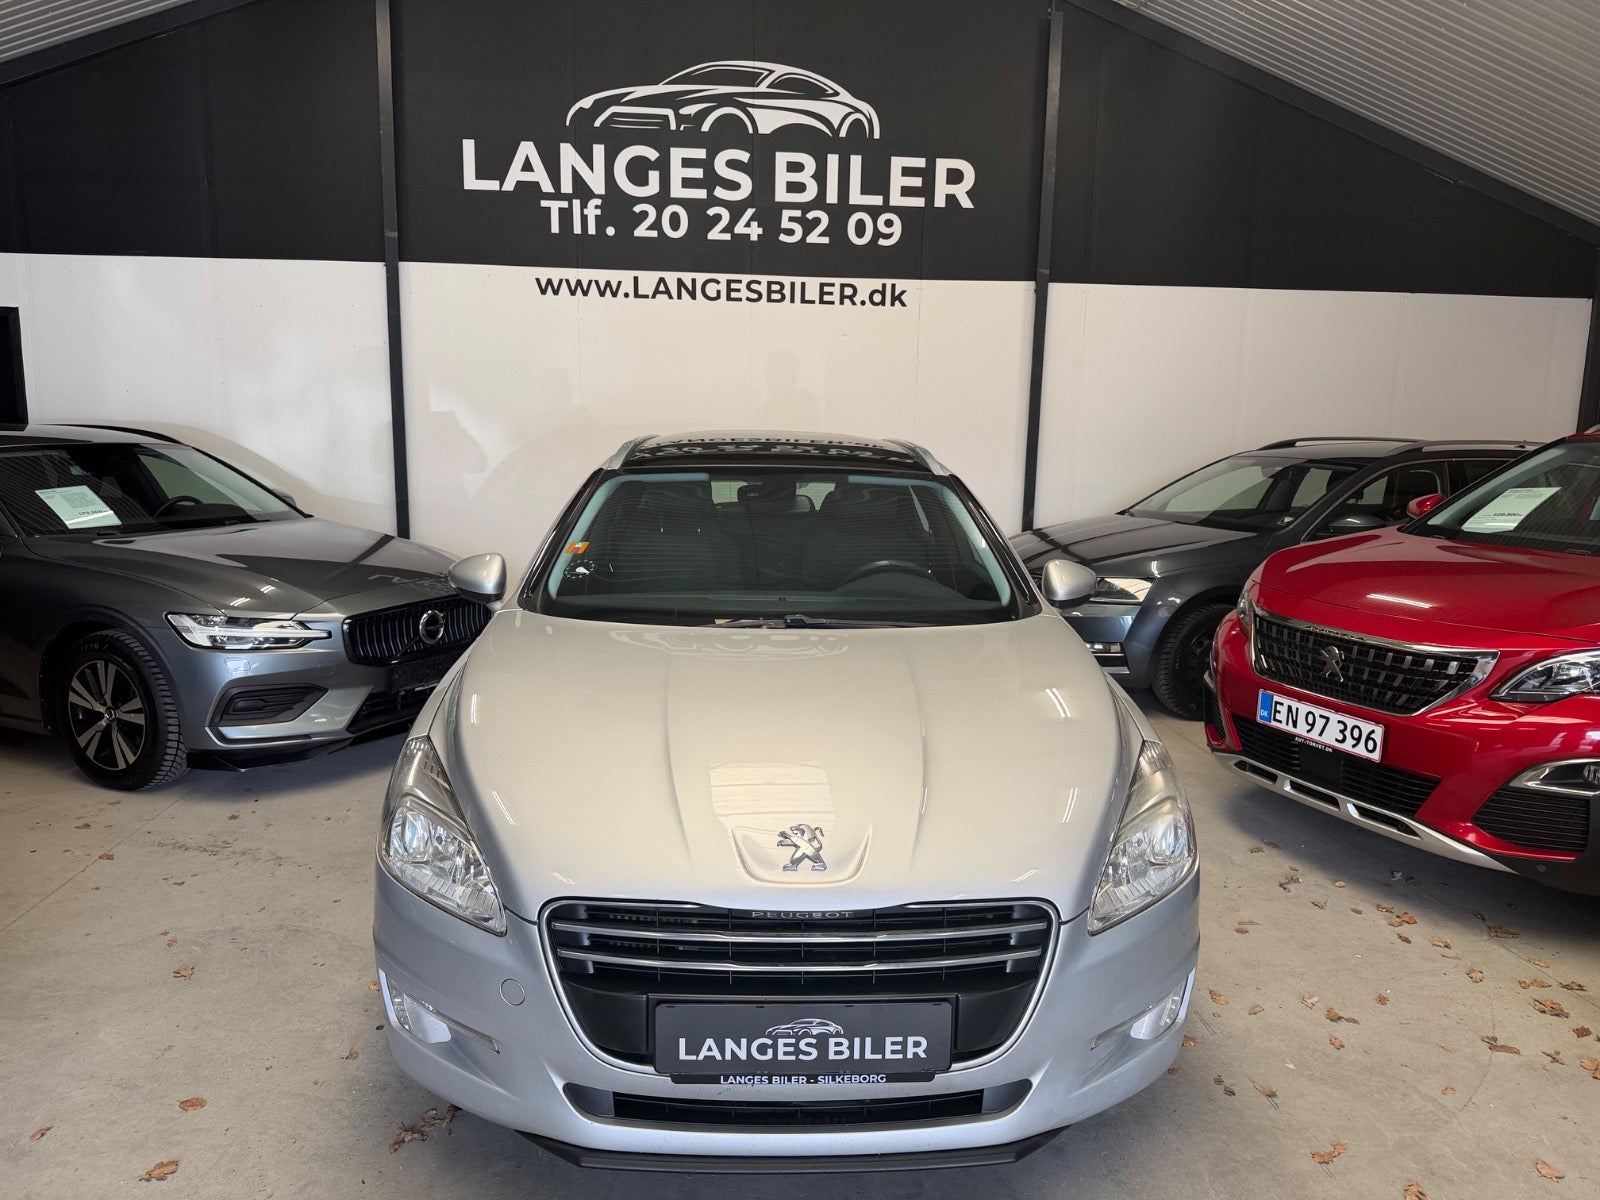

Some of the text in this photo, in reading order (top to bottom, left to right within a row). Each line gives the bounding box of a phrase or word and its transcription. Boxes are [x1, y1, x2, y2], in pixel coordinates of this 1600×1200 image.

[462, 139, 976, 209] LANGES BILER
[540, 198, 902, 247] Tlf. 20 24 52 09
[535, 275, 908, 308] www.LANGESBILER.dk
[1260, 709, 1269, 717] DK
[1272, 701, 1378, 753] EN 97 396
[751, 911, 854, 919] PEUGEOT
[678, 1036, 928, 1061] LANGES BILER
[720, 1075, 769, 1085] LANGES
[772, 1075, 807, 1085] BILER
[817, 1074, 887, 1085] SILKEBORG
